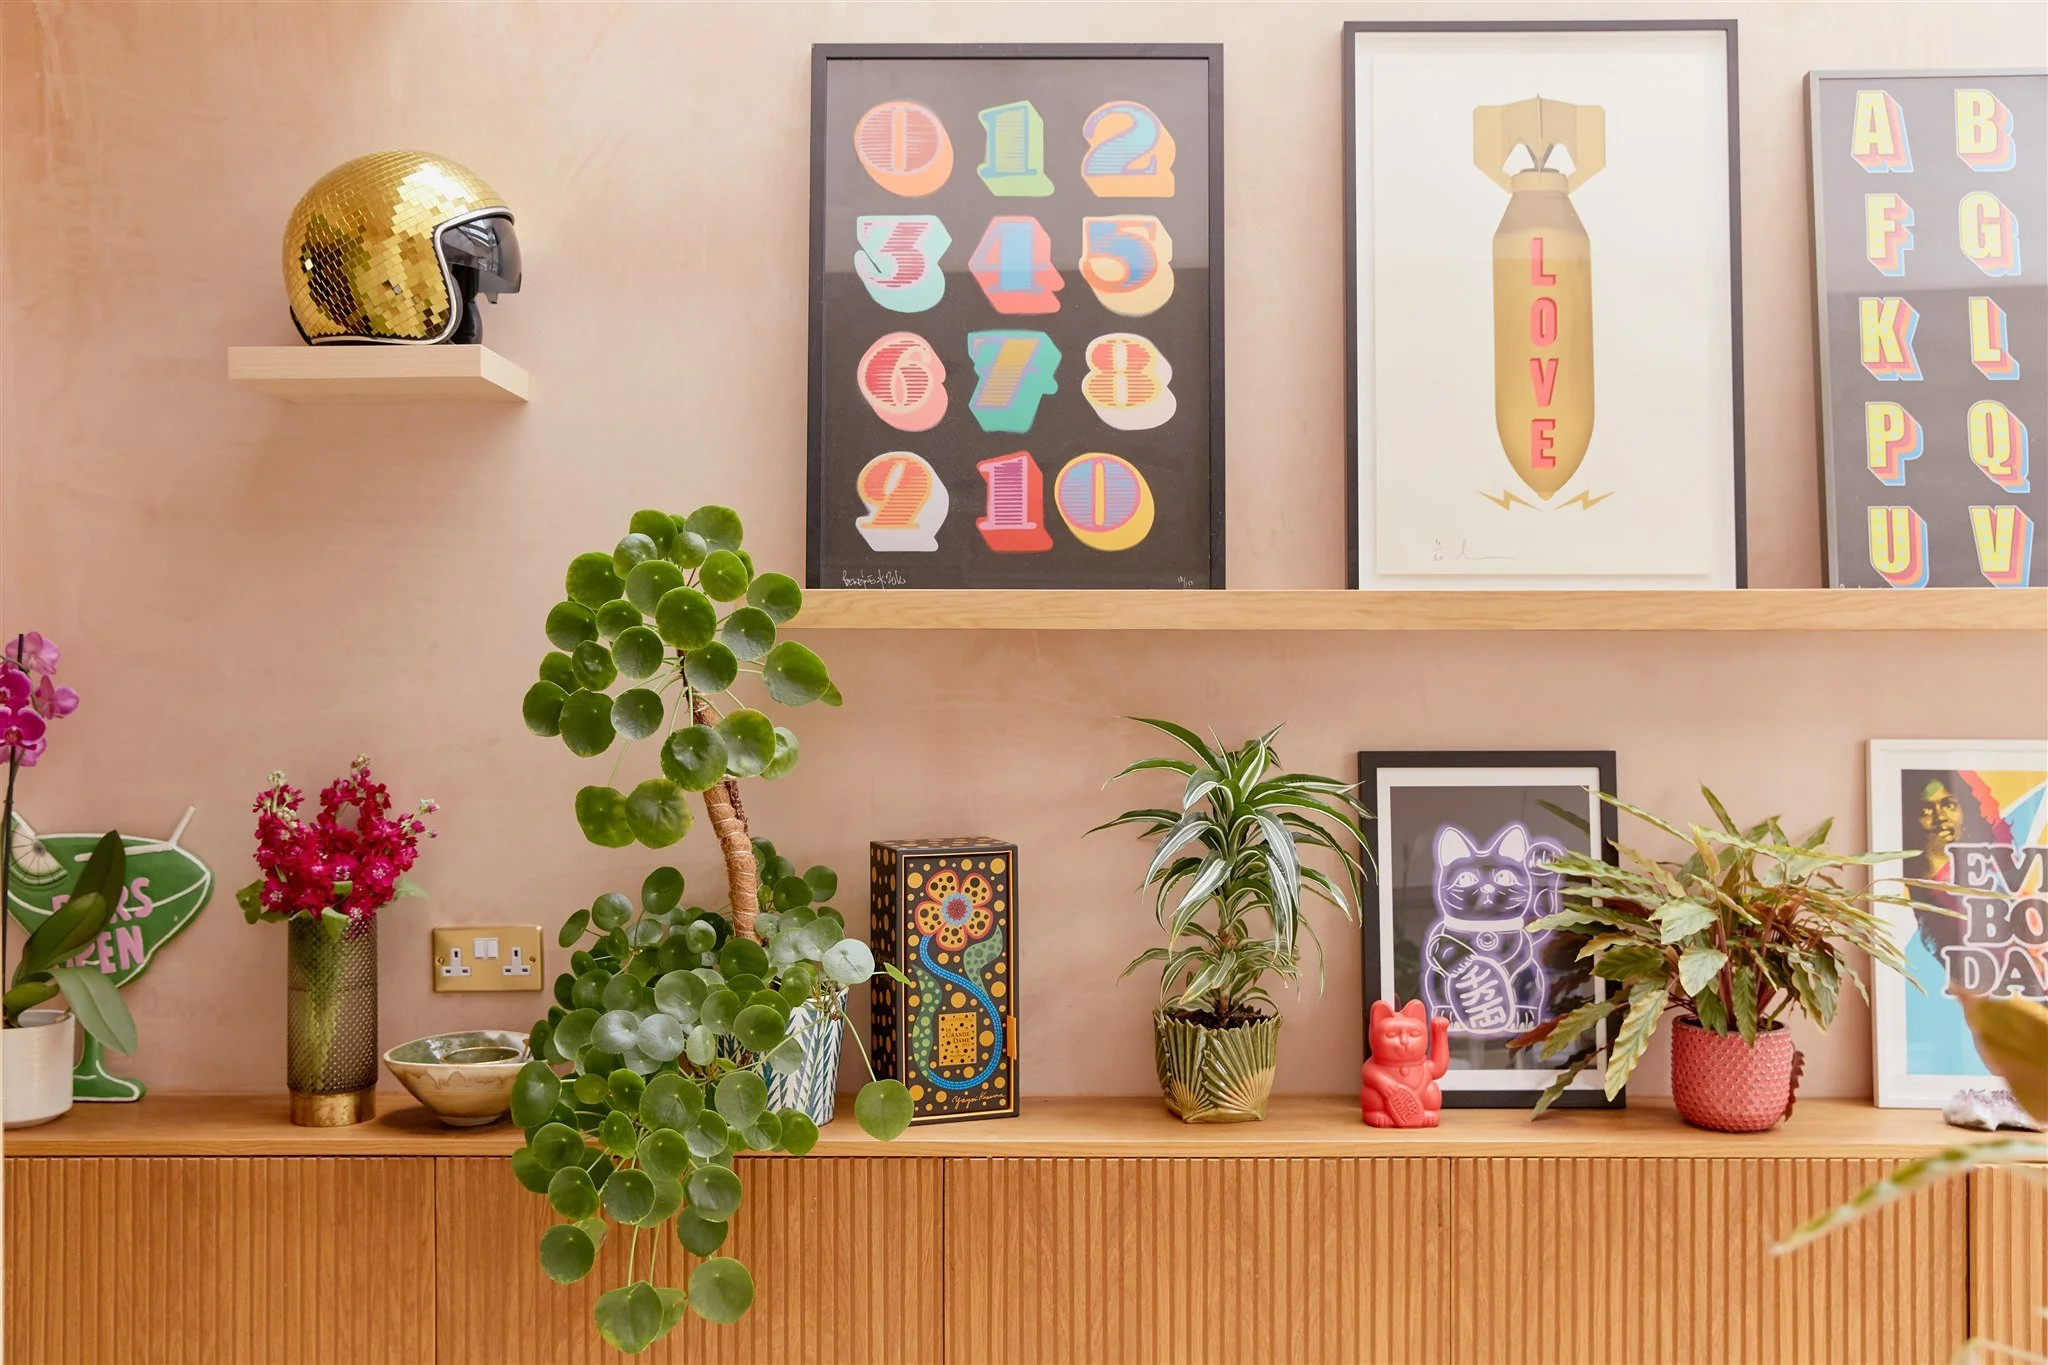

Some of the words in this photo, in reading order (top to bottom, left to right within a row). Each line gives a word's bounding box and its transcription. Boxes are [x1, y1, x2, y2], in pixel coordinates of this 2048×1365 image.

[977, 100, 1055, 197] 1
[1081, 101, 1176, 197] 2
[1851, 90, 1914, 173] A
[1954, 89, 2016, 172] B
[854, 215, 952, 313] 3
[968, 216, 1065, 315] 4
[1078, 215, 1174, 316] 5
[1865, 193, 1914, 277] F
[1959, 191, 2021, 277] G
[857, 331, 948, 432] 6
[967, 329, 1062, 433] 7
[1081, 332, 1177, 431] 8
[1529, 237, 1559, 469] LOVE
[1859, 297, 1923, 381] K
[1968, 296, 2020, 380] L
[1865, 402, 1924, 486] P
[1967, 400, 2030, 493] Q
[855, 451, 949, 552] 9
[1868, 506, 1930, 589] U
[1968, 505, 2034, 588] V
[1944, 843, 2048, 896] EV
